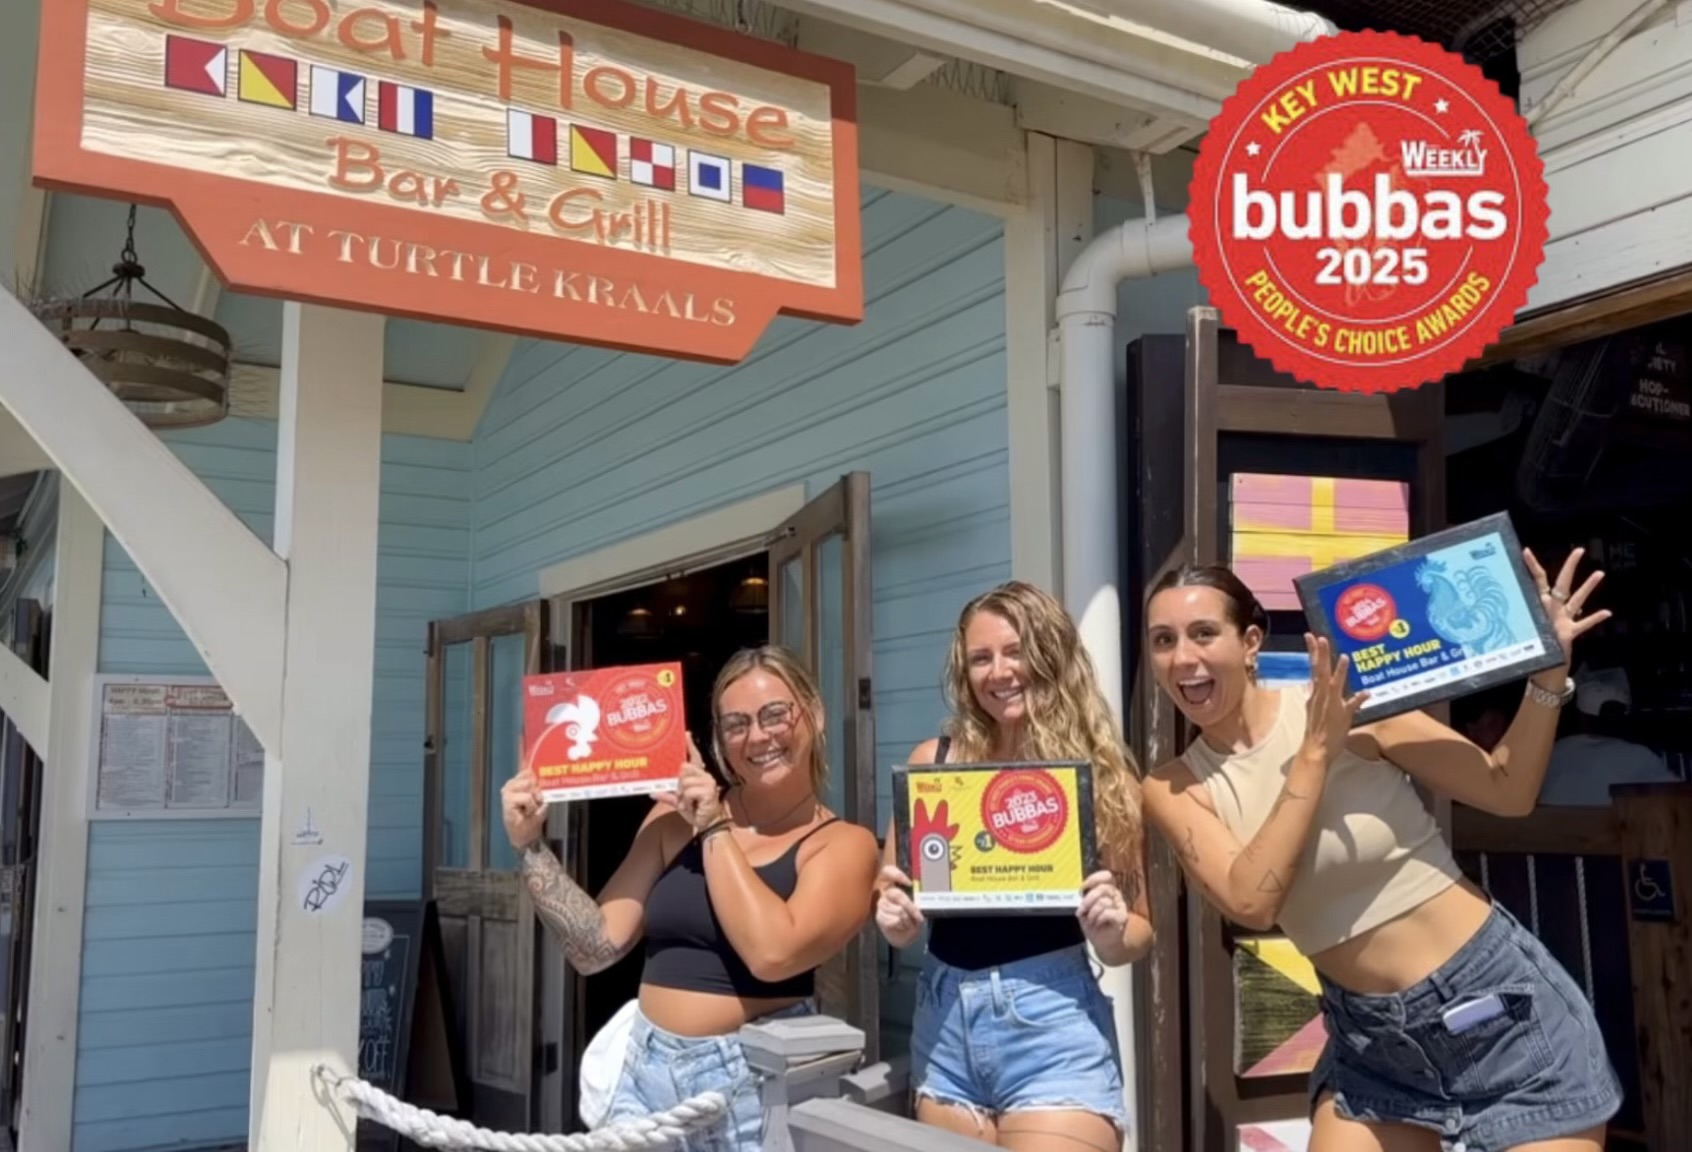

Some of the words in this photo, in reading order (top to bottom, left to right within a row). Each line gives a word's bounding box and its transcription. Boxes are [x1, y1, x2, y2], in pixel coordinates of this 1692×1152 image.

[482, 14, 796, 148] House
[324, 135, 460, 206] Bar
[480, 171, 530, 224] &
[548, 186, 671, 252] Grill
[238, 218, 315, 255] AT
[327, 230, 541, 294] TURTLE
[552, 269, 736, 327] KRAALS
[1351, 643, 1386, 662] BEST
[1356, 650, 1402, 673] HAPPY
[1404, 639, 1441, 658] HOUR
[1360, 671, 1387, 686] Boat
[1386, 663, 1419, 678] House
[1420, 655, 1439, 668] Bar
[1441, 652, 1450, 662] &
[606, 698, 668, 727] BUBBAS
[538, 764, 568, 777] BEST
[571, 761, 612, 773] HAPPY
[614, 756, 648, 769] HOUR
[991, 797, 1060, 829] BUBBAS
[970, 865, 993, 874] BEST
[995, 865, 1026, 873] HAPPY
[1028, 864, 1054, 872] HOUR
